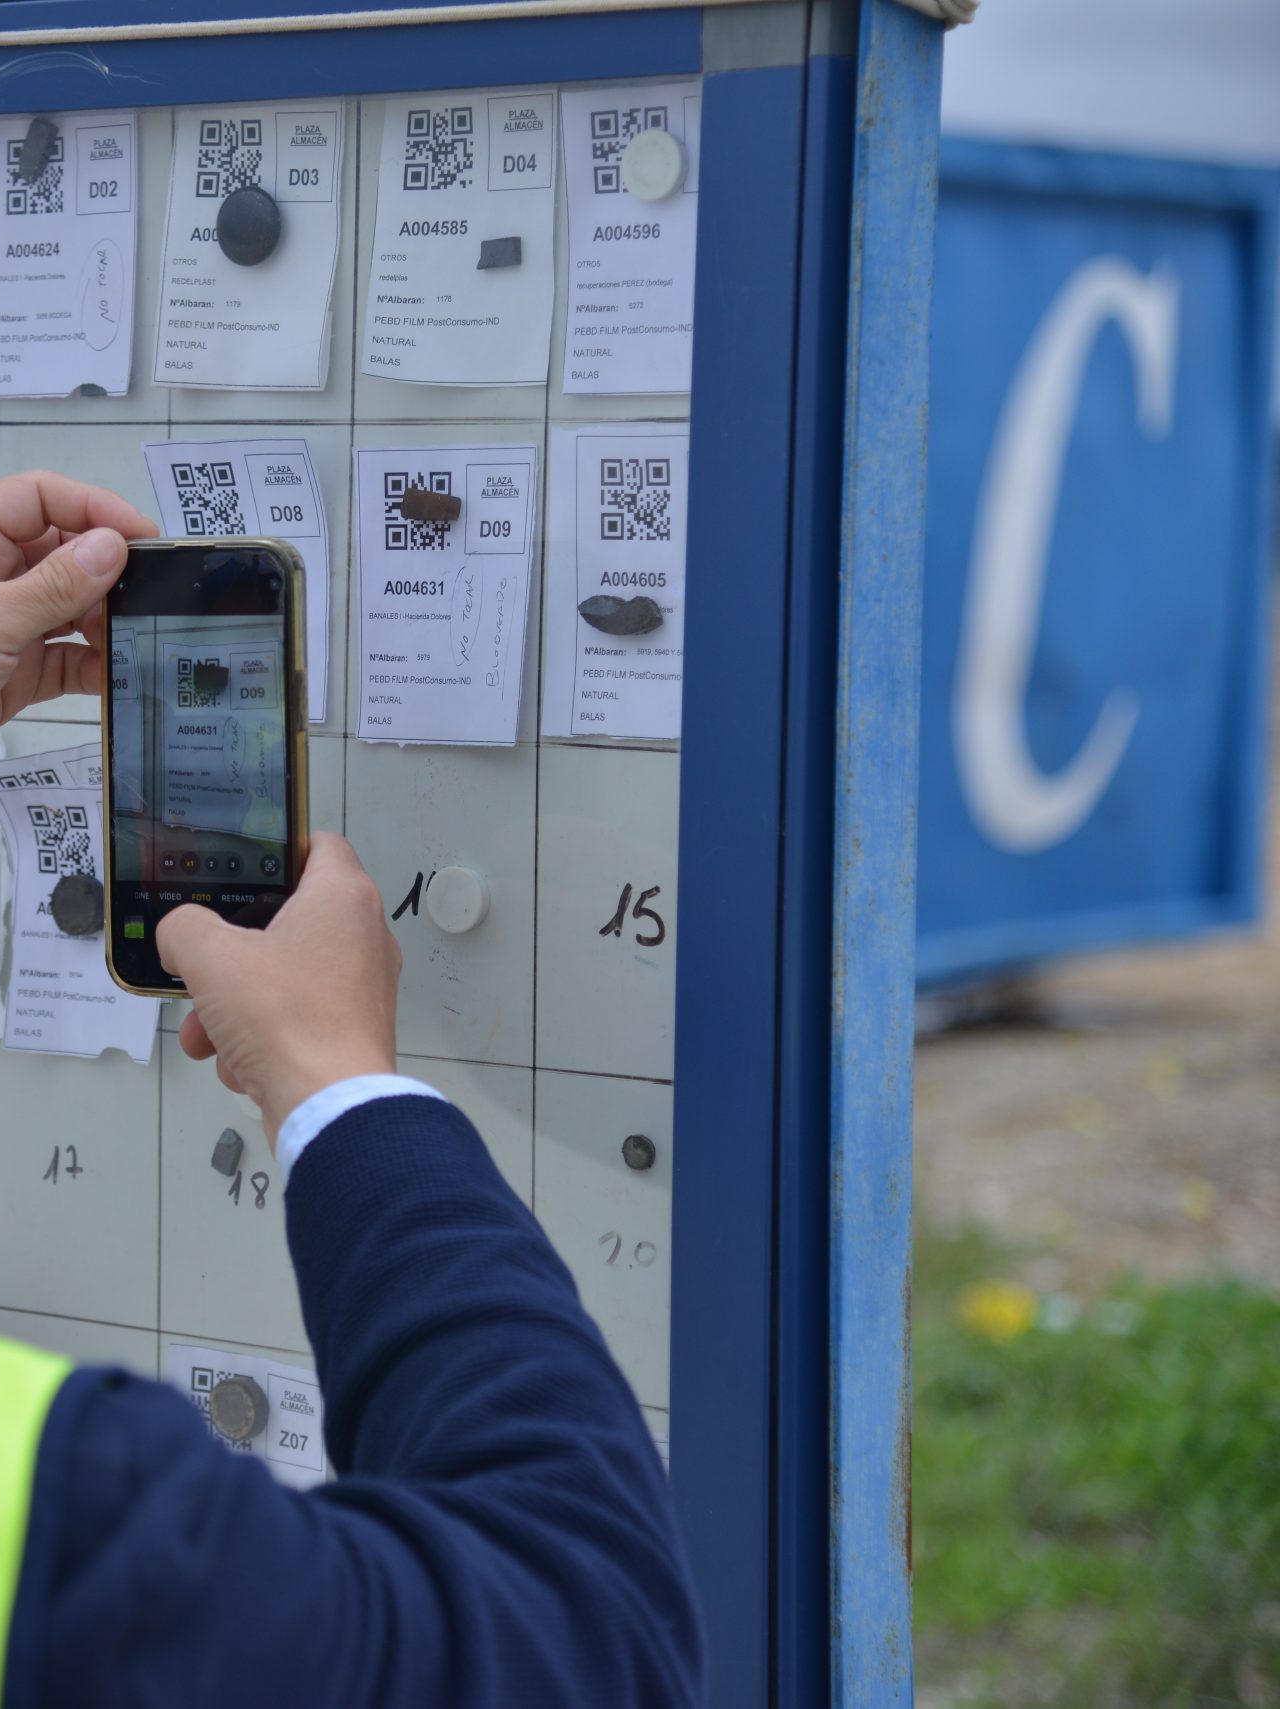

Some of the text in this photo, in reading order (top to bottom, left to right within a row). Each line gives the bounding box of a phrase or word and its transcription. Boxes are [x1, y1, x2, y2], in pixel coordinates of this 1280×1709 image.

[508, 108, 536, 119] PLAZA
[295, 125, 321, 134] PLAZA
[93, 138, 117, 148] PLAZA
[503, 153, 537, 174] D04
[288, 168, 320, 186] D03
[89, 180, 118, 198] D02
[399, 220, 468, 236] A004585
[592, 222, 661, 242] A004596
[6, 242, 60, 258] A004624
[172, 257, 198, 266] OTROS
[380, 254, 407, 262] OTROS
[576, 260, 601, 269] OTROS
[171, 277, 216, 286] REDELPLAST
[379, 273, 408, 283] redelplas
[576, 279, 673, 290] recuperaciones PEREZ (bodega)
[436, 295, 452, 303] 1178
[98, 299, 115, 323] NO
[168, 320, 280, 332] PEBD FILM PostConsumo-IND
[374, 315, 500, 327] PEBD FILM PostConsumo-IND
[574, 326, 598, 336] PEBD
[599, 326, 619, 335] FILM
[12, 334, 28, 343] FILM
[371, 335, 417, 347] NATURAL
[166, 340, 208, 350] NATURAL
[573, 348, 612, 358] NATURAL
[164, 360, 193, 370] BALAS
[370, 354, 401, 366] BALAS
[571, 370, 599, 380] BALAS
[267, 465, 292, 475] PLAZA
[486, 477, 513, 486] PLAZA
[480, 486, 519, 497] ALMACÉN
[270, 505, 304, 522] D08
[479, 520, 511, 538] D09
[600, 571, 667, 587] A004605
[384, 580, 444, 596] A004631
[369, 612, 399, 620] BANALES
[430, 613, 451, 621] Dolores
[460, 635, 470, 662] NO
[369, 675, 472, 685] PEBD FILM PostConsumo-IND
[583, 669, 682, 681] PEBD FILM PostConsumo
[240, 687, 265, 699] D09
[581, 690, 619, 700] NATURAL
[368, 695, 403, 704] NATURAL
[367, 716, 392, 725] BALAS
[580, 712, 605, 721] BALAS
[177, 725, 217, 736] A004631
[159, 890, 182, 901] VÍDEO
[191, 894, 211, 902] FOTO
[221, 895, 255, 903] RETRATO
[391, 870, 437, 921] 1
[599, 882, 666, 947] 15
[17, 988, 41, 998] PEBD
[42, 990, 61, 999] FILM
[16, 1008, 55, 1019] NATURAL
[13, 1027, 43, 1037] BALAS
[42, 1144, 83, 1184] 17
[227, 1170, 269, 1209] 18
[283, 1390, 308, 1403] PLAZA
[279, 1430, 308, 1451] Z07
